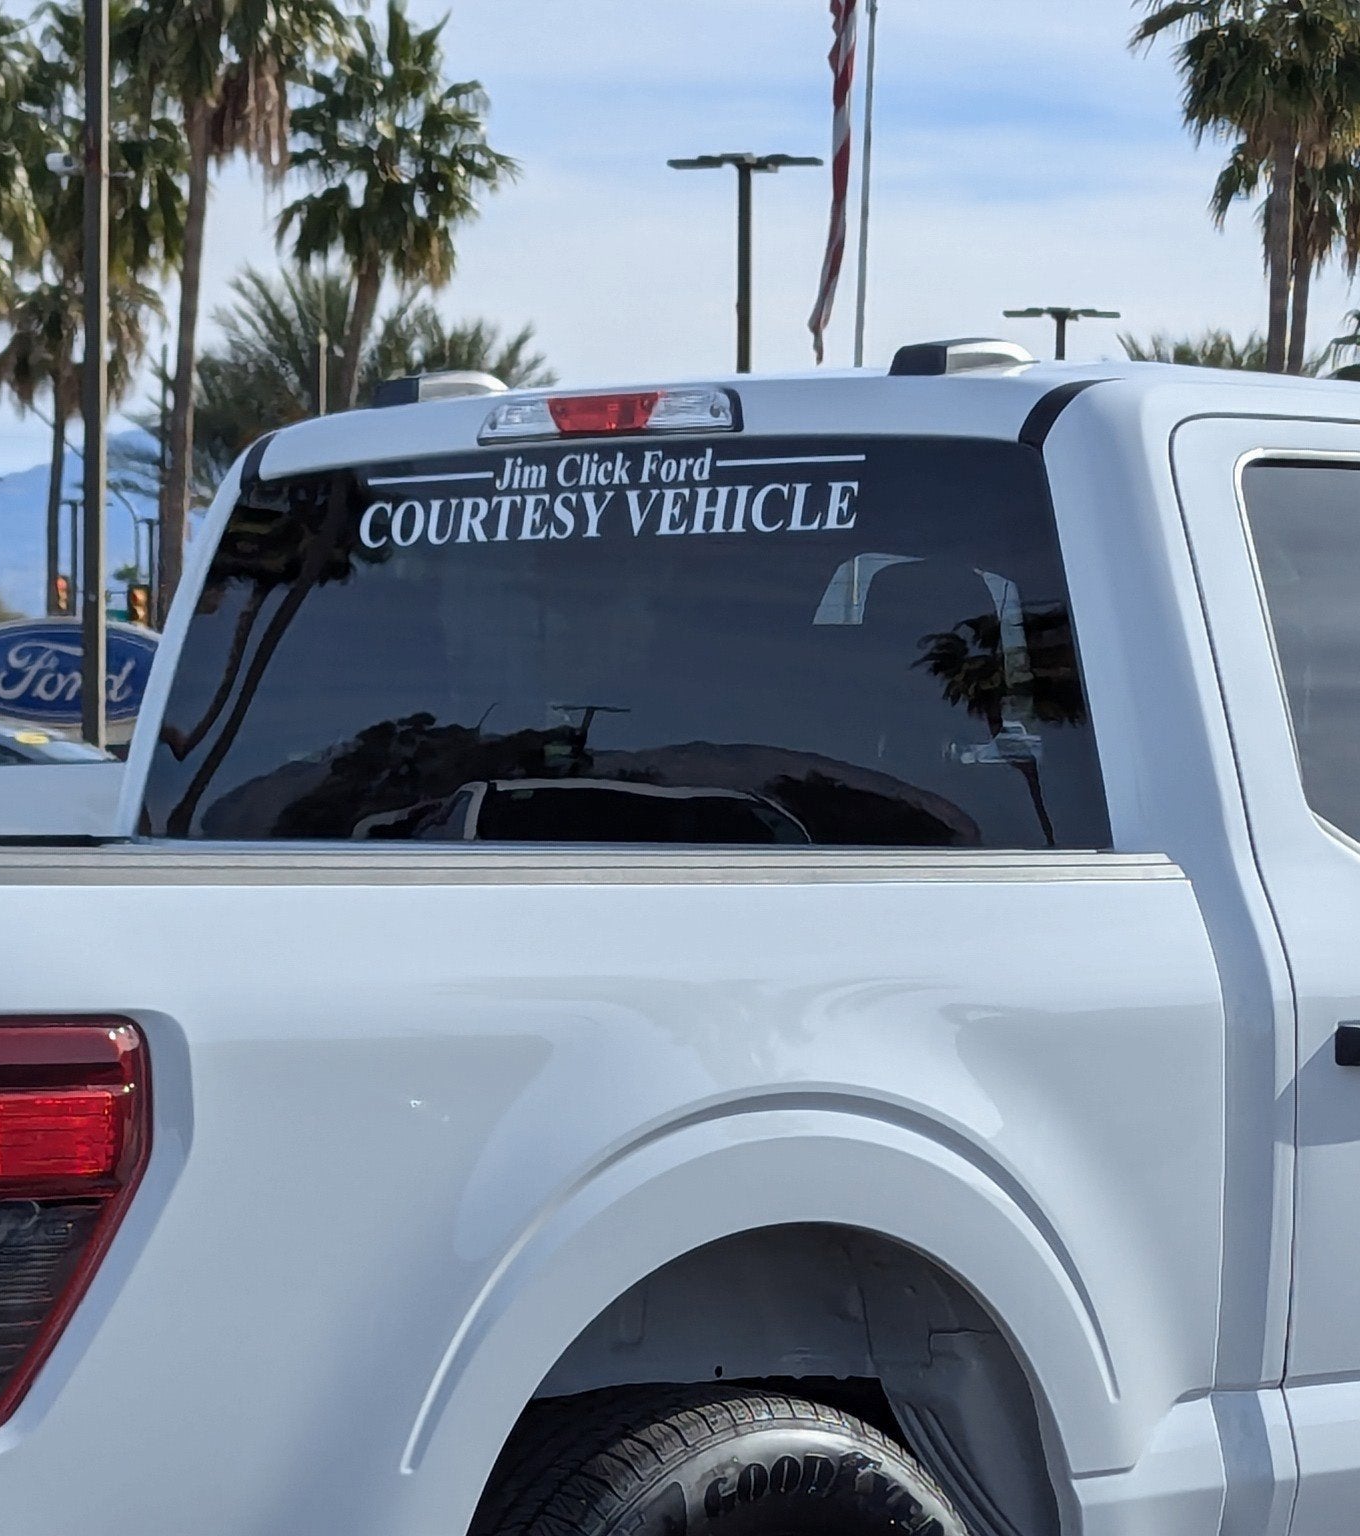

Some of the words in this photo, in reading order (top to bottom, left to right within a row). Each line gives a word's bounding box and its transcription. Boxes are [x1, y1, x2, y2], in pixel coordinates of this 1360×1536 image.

[495, 457, 547, 491] Jim
[556, 453, 632, 487] Click
[640, 447, 714, 483] Ford
[359, 489, 613, 549] COURTESY
[625, 481, 859, 537] VEHICLE
